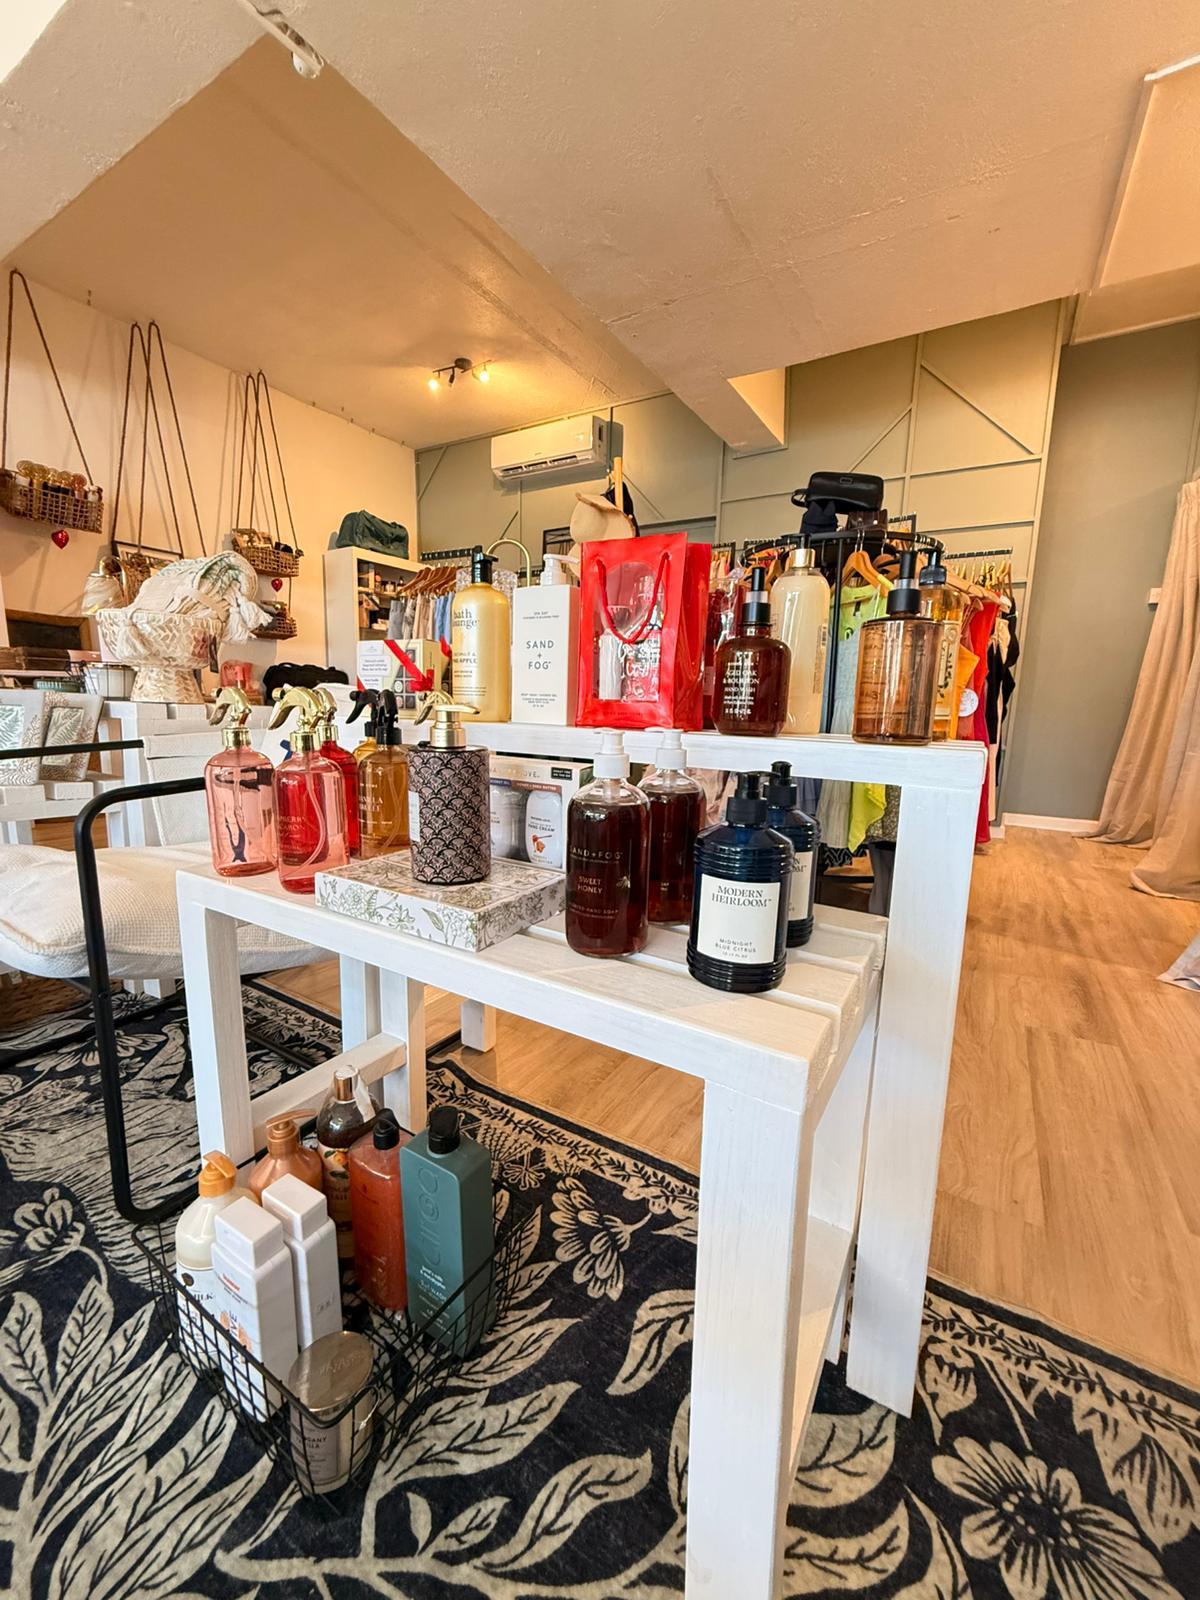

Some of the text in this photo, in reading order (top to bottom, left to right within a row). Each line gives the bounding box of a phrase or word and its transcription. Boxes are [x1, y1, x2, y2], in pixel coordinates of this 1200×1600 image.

[526, 640, 554, 650] SAND
[579, 876, 601, 886] SWEET
[577, 885, 603, 894] HONEY
[717, 885, 764, 898] MODERN
[715, 942, 730, 951] BLUE
[719, 938, 753, 947] MIDNIGHT
